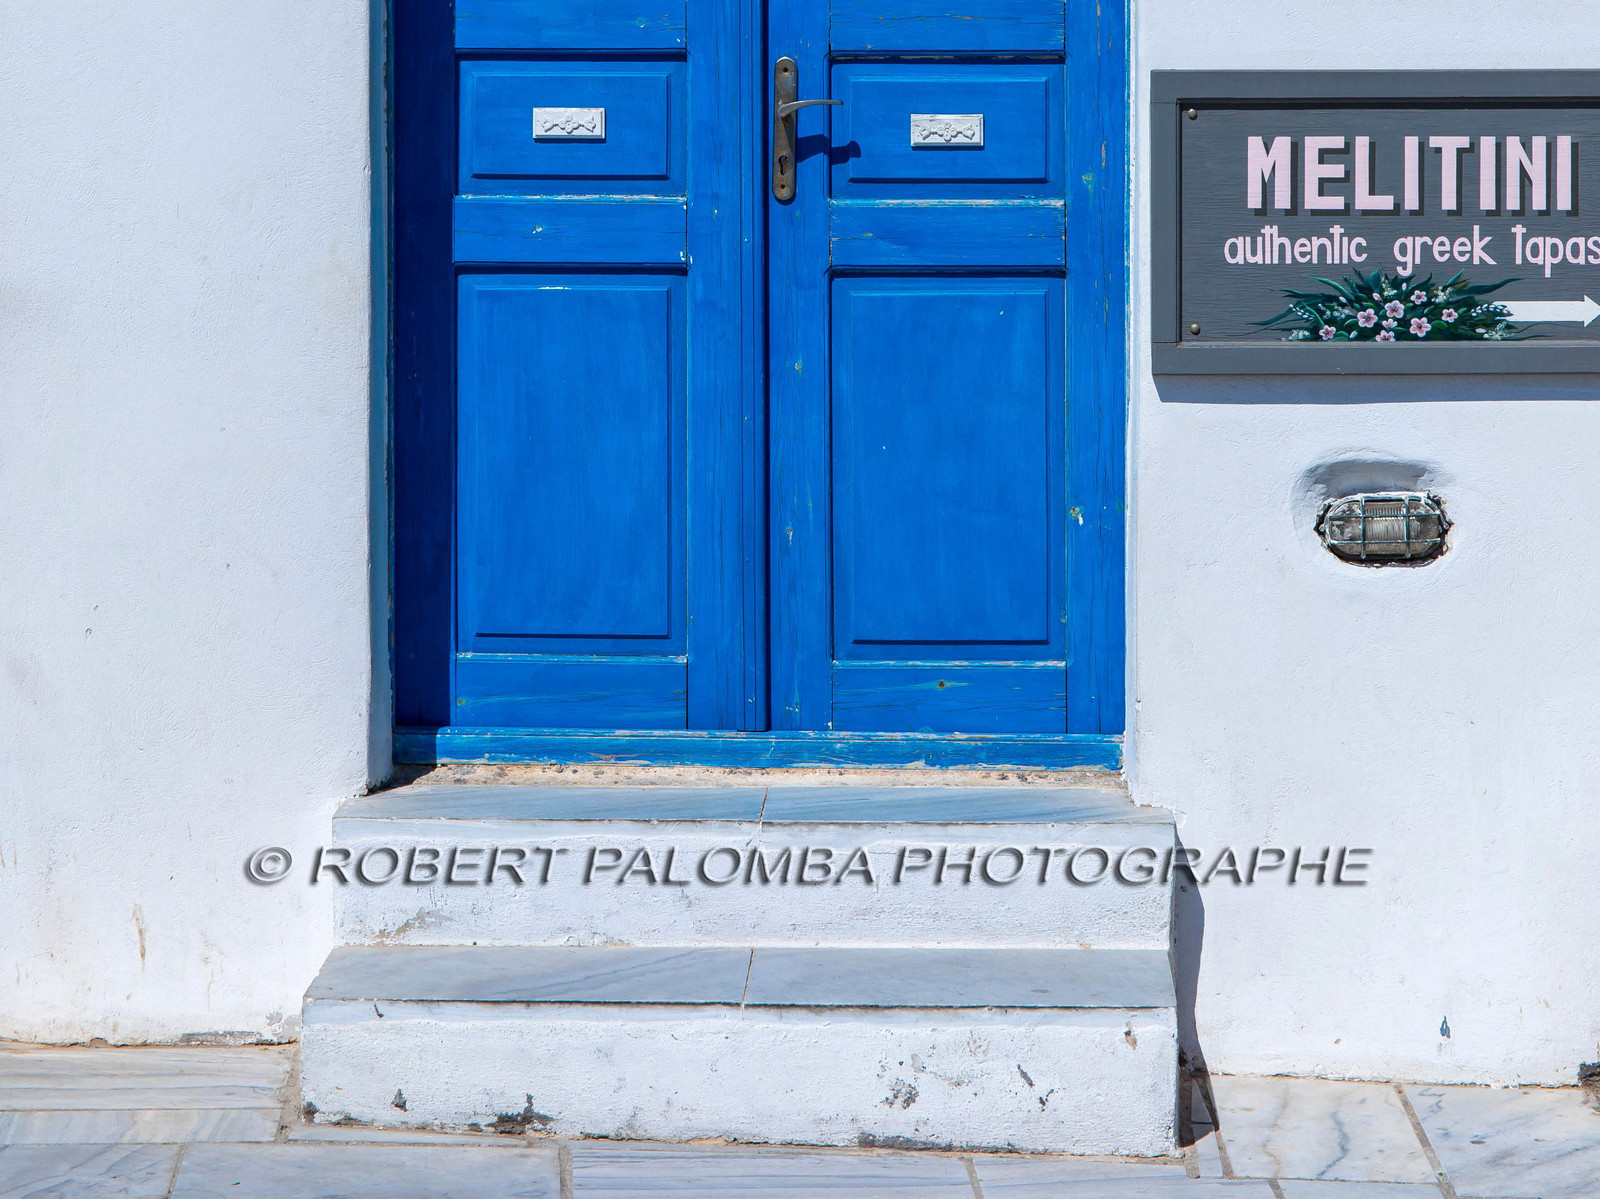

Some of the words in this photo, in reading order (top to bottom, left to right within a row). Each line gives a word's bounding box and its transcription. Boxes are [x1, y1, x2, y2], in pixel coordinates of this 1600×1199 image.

[1247, 135, 1572, 211] MELITINI
[1223, 224, 1368, 265] authentic
[1393, 224, 1498, 277] greek
[1511, 224, 1600, 279] tapas
